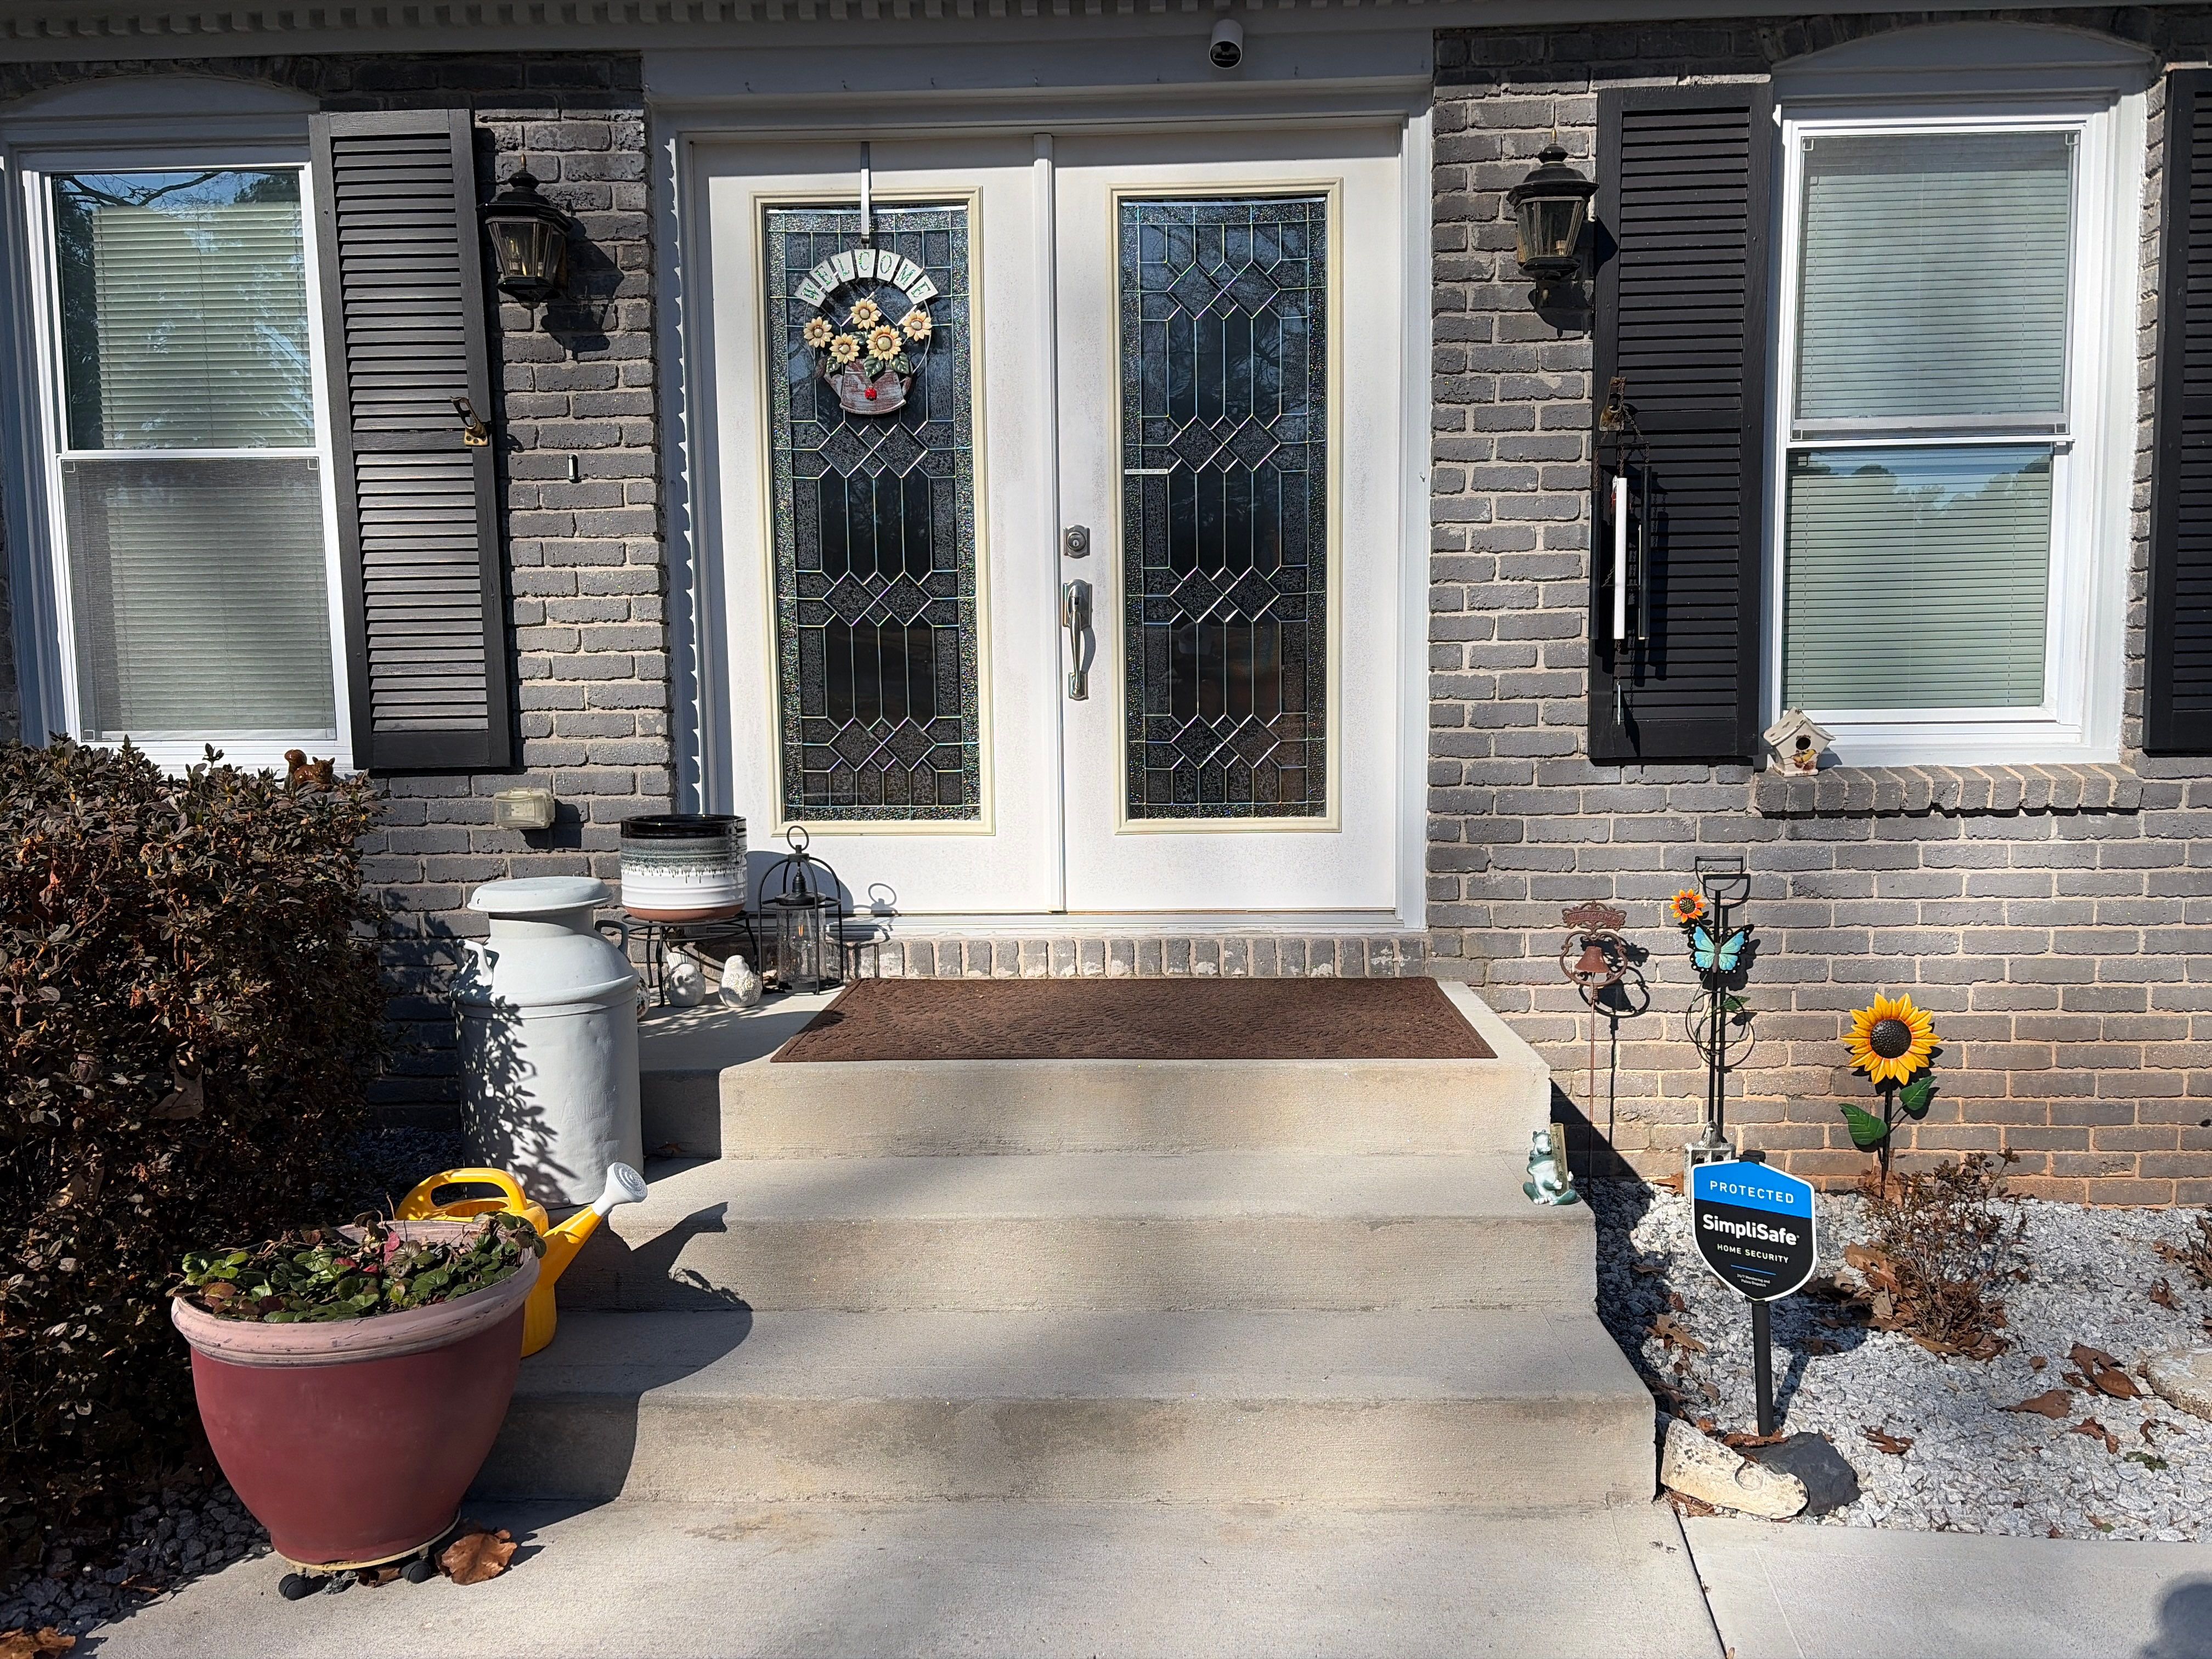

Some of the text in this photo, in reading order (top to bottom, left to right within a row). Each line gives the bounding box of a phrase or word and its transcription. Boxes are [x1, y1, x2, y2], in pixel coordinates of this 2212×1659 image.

[799, 250, 932, 301] WELCOME
[1570, 911, 1618, 921] WELCOME
[1710, 1180, 1794, 1204] PROTECTED
[1717, 1243, 1789, 1263] HOME SECURITY
